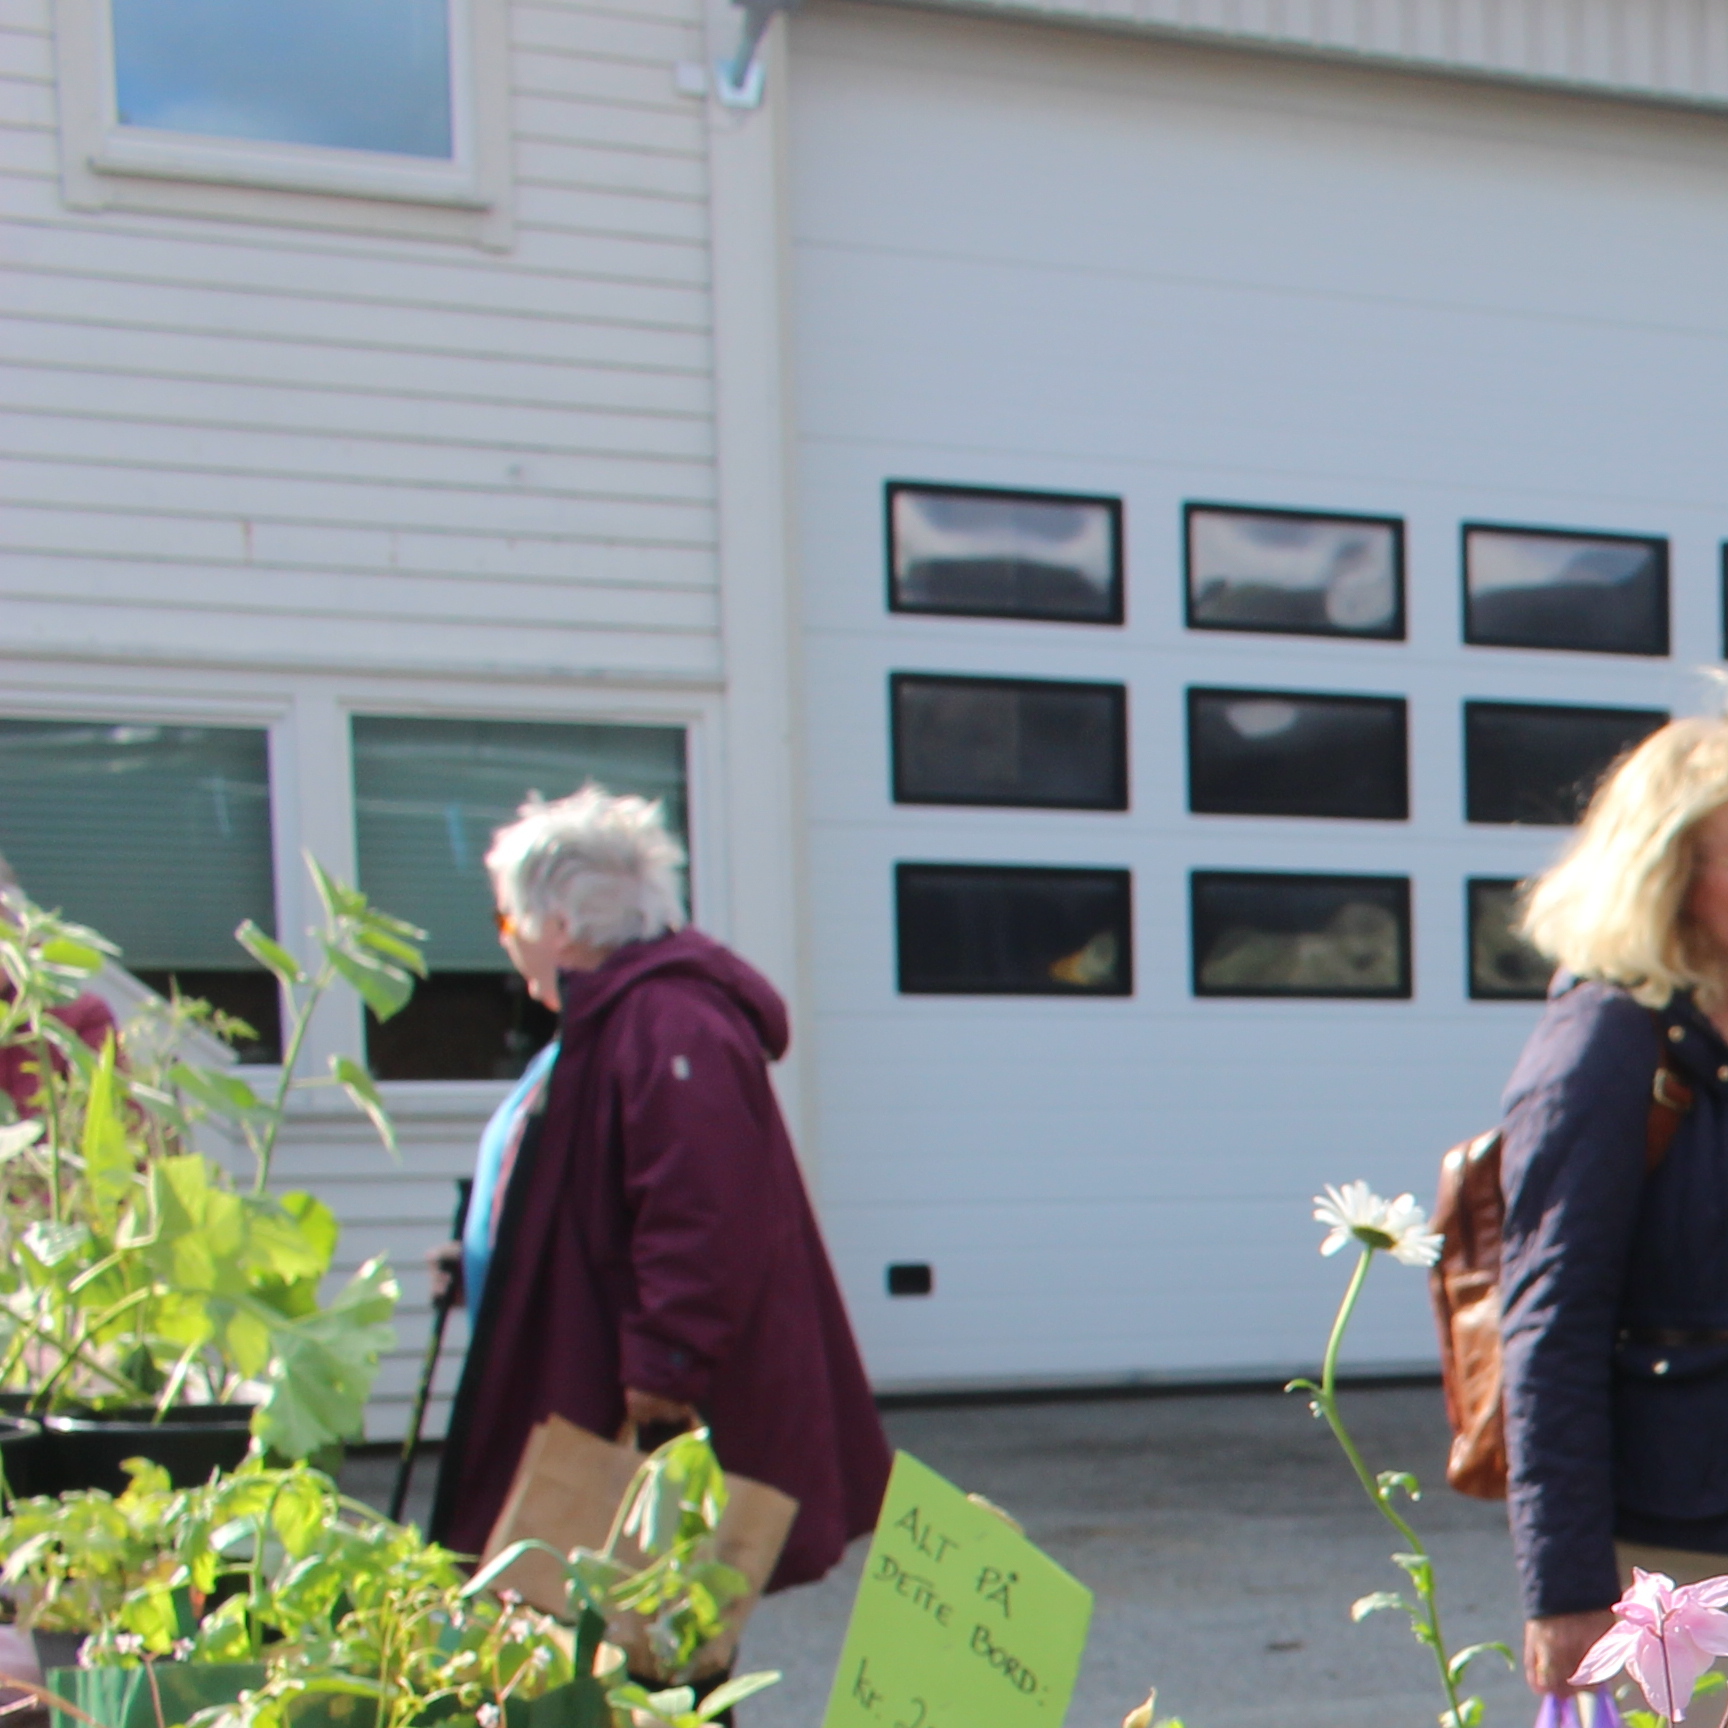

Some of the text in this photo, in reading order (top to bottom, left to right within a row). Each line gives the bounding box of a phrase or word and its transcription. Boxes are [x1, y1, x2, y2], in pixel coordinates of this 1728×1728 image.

[873, 1555, 953, 1628] DETTE
[894, 1505, 1019, 1620] ALT PÅ
